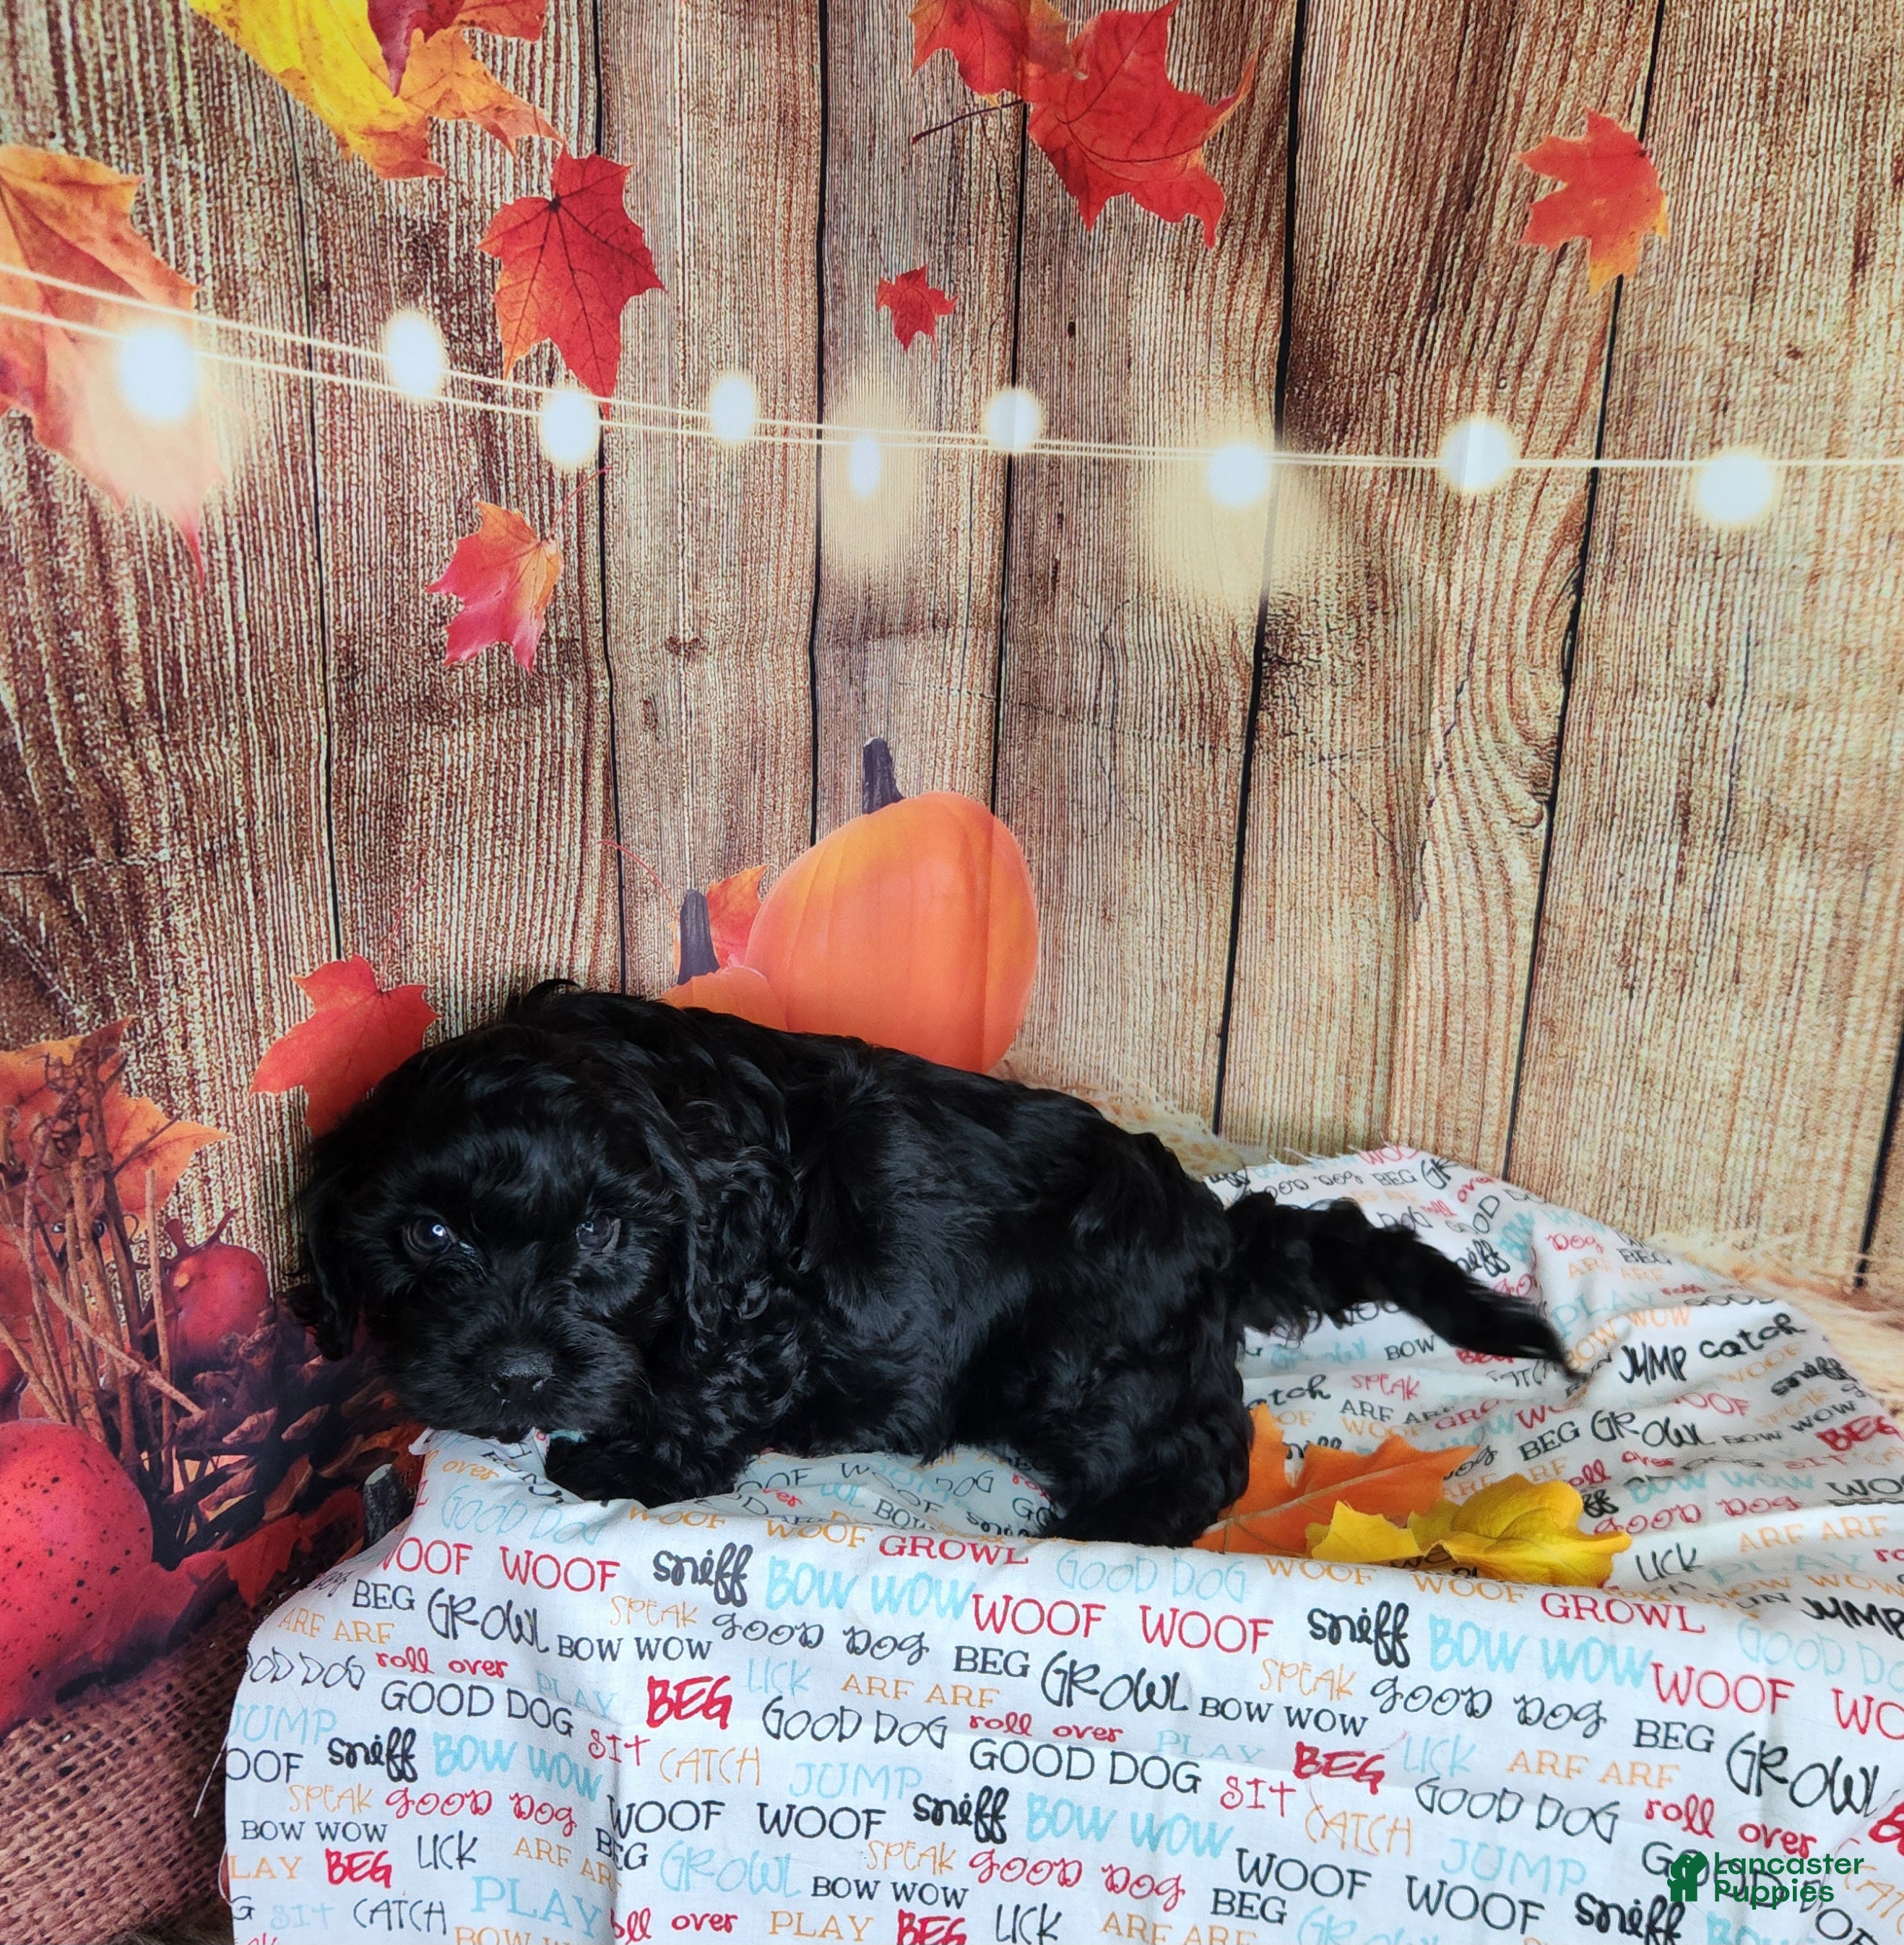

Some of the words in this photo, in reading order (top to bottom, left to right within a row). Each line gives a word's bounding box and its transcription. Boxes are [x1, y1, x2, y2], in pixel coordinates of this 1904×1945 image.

[1372, 1169, 1417, 1185] BEG
[1455, 1239, 1510, 1277] niff
[1627, 1307, 1692, 1327] WOW
[1700, 1312, 1806, 1359] catch
[1384, 1335, 1435, 1361] BOW
[1351, 1374, 1420, 1401] SPEAK
[1339, 1399, 1394, 1422] ARF
[1591, 1410, 1716, 1447] GROWL
[1789, 1400, 1856, 1433] WOW
[1518, 1421, 1580, 1461] BEG
[442, 1460, 499, 1481] over
[1568, 1459, 1611, 1486] oll
[1825, 1478, 1904, 1496] WO
[441, 1484, 528, 1535] GOOD
[766, 1519, 873, 1548] WOOF
[878, 1534, 1029, 1566] GROWL
[1739, 1523, 1804, 1553] ARF
[1821, 1515, 1889, 1541] ARF
[499, 1546, 621, 1593] WOOF
[652, 1541, 753, 1608] sniff
[1056, 1549, 1157, 1594] GOOD
[1172, 1555, 1247, 1603] DOG
[1265, 1558, 1373, 1585] WOOF
[1412, 1574, 1528, 1604] WOOF
[1635, 1542, 1704, 1582] LICK
[352, 1578, 415, 1610] BEG
[765, 1554, 860, 1611] BOW
[871, 1569, 977, 1620] WOW
[277, 1606, 324, 1638] ARF
[332, 1620, 394, 1645] ARF
[428, 1587, 550, 1655] GROWL
[610, 1595, 698, 1628] SPEAK
[972, 1594, 1107, 1638] WOOF
[1139, 1604, 1274, 1654] WOOF
[1540, 1592, 1706, 1634] GROWL
[557, 1634, 623, 1662] BOW
[636, 1637, 714, 1662] WOW
[1307, 1600, 1411, 1668] sniff
[1428, 1613, 1528, 1673] BOW
[1541, 1634, 1653, 1689] WOW
[299, 1652, 365, 1691] DOG
[376, 1646, 434, 1676] roll
[449, 1658, 509, 1679] over
[953, 1645, 1030, 1678] BEG
[1737, 1618, 1845, 1677] GOOD
[1857, 1640, 1904, 1694] DO
[535, 1669, 620, 1720] PLAY
[746, 1658, 813, 1697] LICK
[840, 1673, 914, 1702] ARF
[923, 1683, 1000, 1710] ARF
[1041, 1650, 1190, 1712] GROWL
[1260, 1658, 1357, 1702] SPEAK
[1651, 1661, 1795, 1715] WOOF
[381, 1680, 494, 1717] GOOD
[506, 1687, 575, 1738] DOG
[646, 1673, 734, 1730] BEG
[762, 1695, 863, 1743] GOOD
[873, 1710, 948, 1749] DOG
[1198, 1697, 1276, 1725] BOW
[1284, 1704, 1368, 1738] WOW
[969, 1712, 1033, 1738] roll
[1052, 1723, 1124, 1743] over
[1156, 1730, 1265, 1764] PLAY
[1632, 1718, 1715, 1752] BEG
[225, 1747, 304, 1784] OOF
[327, 1726, 419, 1783] sniff
[433, 1730, 519, 1777] BOW
[527, 1745, 604, 1802] WOW
[659, 1746, 763, 1786] CATCH
[969, 1737, 1096, 1782] GOOD
[1109, 1749, 1202, 1795] DOG
[1292, 1741, 1387, 1795] BEG
[1402, 1733, 1478, 1777] LICK
[1505, 1749, 1589, 1781] ARF
[1596, 1760, 1681, 1790] ARF
[1726, 1730, 1881, 1817] GROWL
[288, 1783, 373, 1815] SPEAK
[789, 1762, 923, 1801] JUMP
[606, 1794, 726, 1840] WOOF
[757, 1801, 888, 1840] WOOF
[913, 1785, 1010, 1844] sniff
[1026, 1791, 1119, 1843] BOW
[1130, 1808, 1237, 1859] WOW
[1415, 1775, 1525, 1824] GOOD
[1536, 1792, 1621, 1845] DOG
[1645, 1793, 1715, 1839] roll
[1739, 1824, 1817, 1859] over
[241, 1819, 307, 1842] BOW
[314, 1821, 388, 1843] WOW
[417, 1829, 478, 1871] LICK
[595, 1827, 648, 1871] BEG
[1304, 1805, 1412, 1858] CATCH
[229, 1855, 304, 1880] LAY
[324, 1847, 393, 1889] BEG
[513, 1836, 573, 1868] ARF
[580, 1858, 622, 1899] AR
[660, 1840, 802, 1899] GROWL
[866, 1839, 957, 1876] SPEAK
[1440, 1837, 1588, 1896] JUMP
[470, 1874, 603, 1940] PLAY
[811, 1876, 882, 1901] BOW
[890, 1881, 970, 1910] WOW
[1211, 1886, 1288, 1925] BEG
[1235, 1847, 1374, 1900] WOOF
[1406, 1874, 1546, 1936] WOOF
[352, 1897, 448, 1936] CATCH
[671, 1912, 739, 1936] over
[769, 1909, 875, 1942] PLAY
[896, 1909, 967, 1945] BEG
[995, 1902, 1063, 1945] LICK
[1575, 1892, 1685, 1945] sniff
